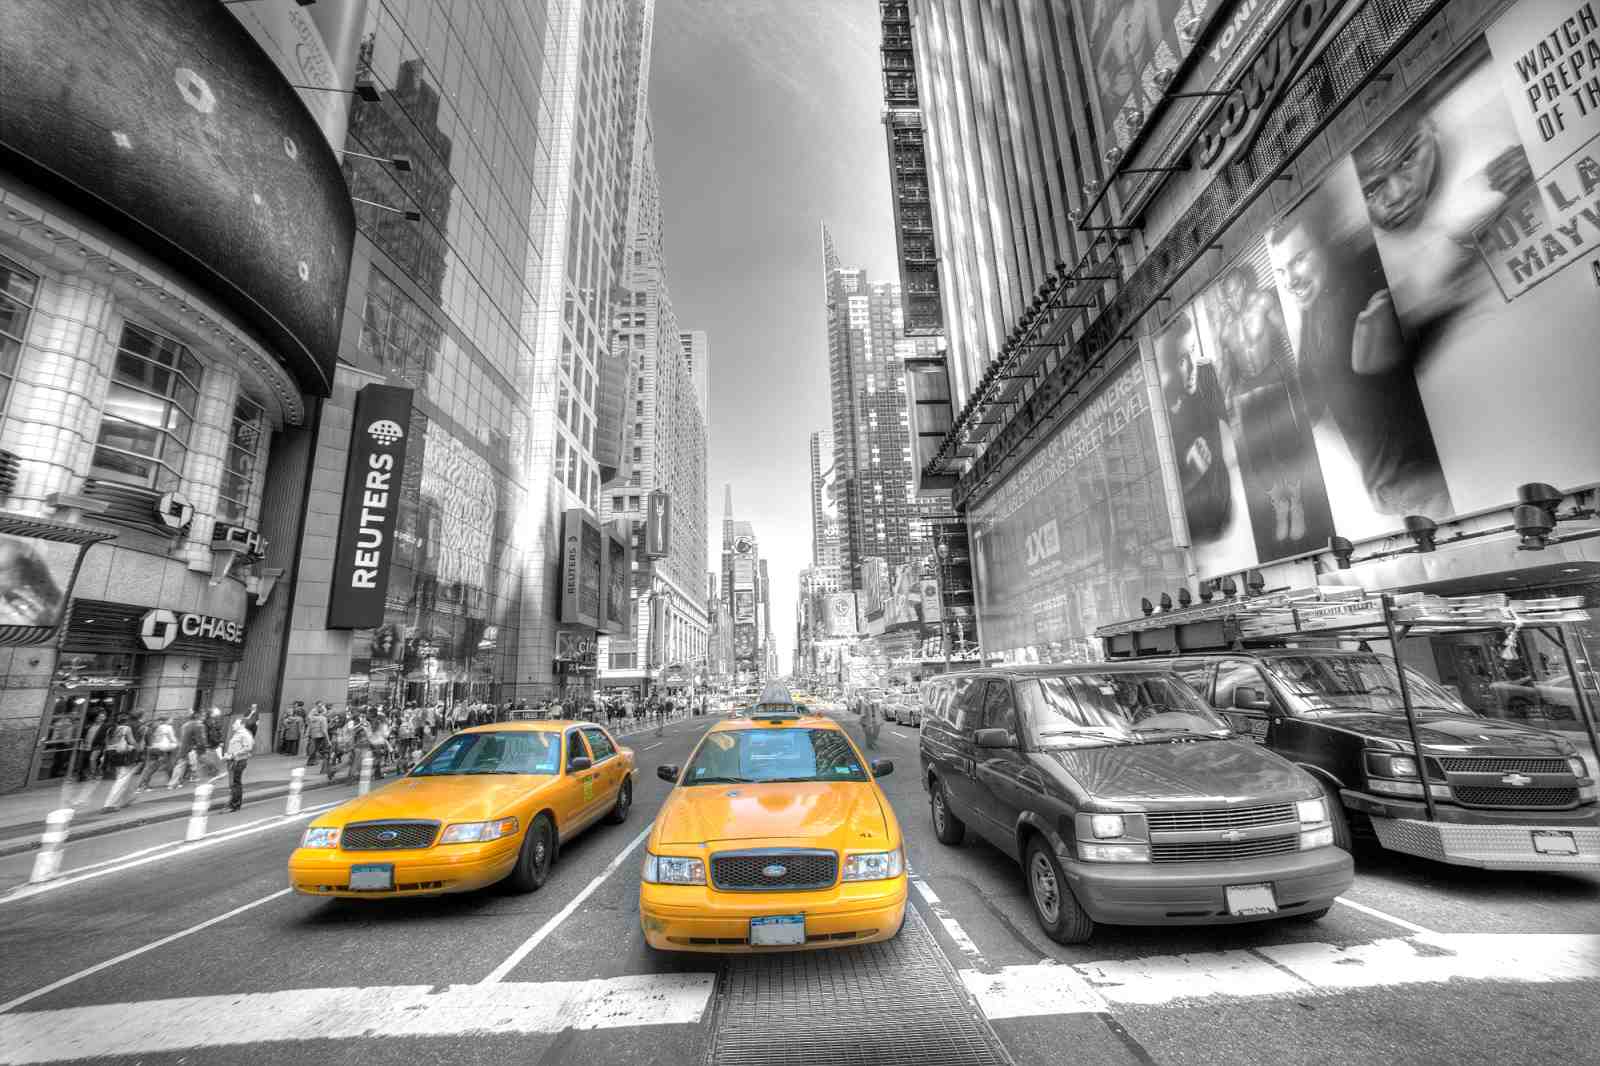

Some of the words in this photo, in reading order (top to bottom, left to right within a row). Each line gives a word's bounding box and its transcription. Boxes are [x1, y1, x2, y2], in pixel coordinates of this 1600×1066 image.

[1515, 2, 1598, 82] WATCH
[1538, 103, 1565, 142] OF
[1106, 392, 1149, 437] LEVEL
[351, 453, 394, 588] REUTERS
[182, 614, 242, 643] CHASE
